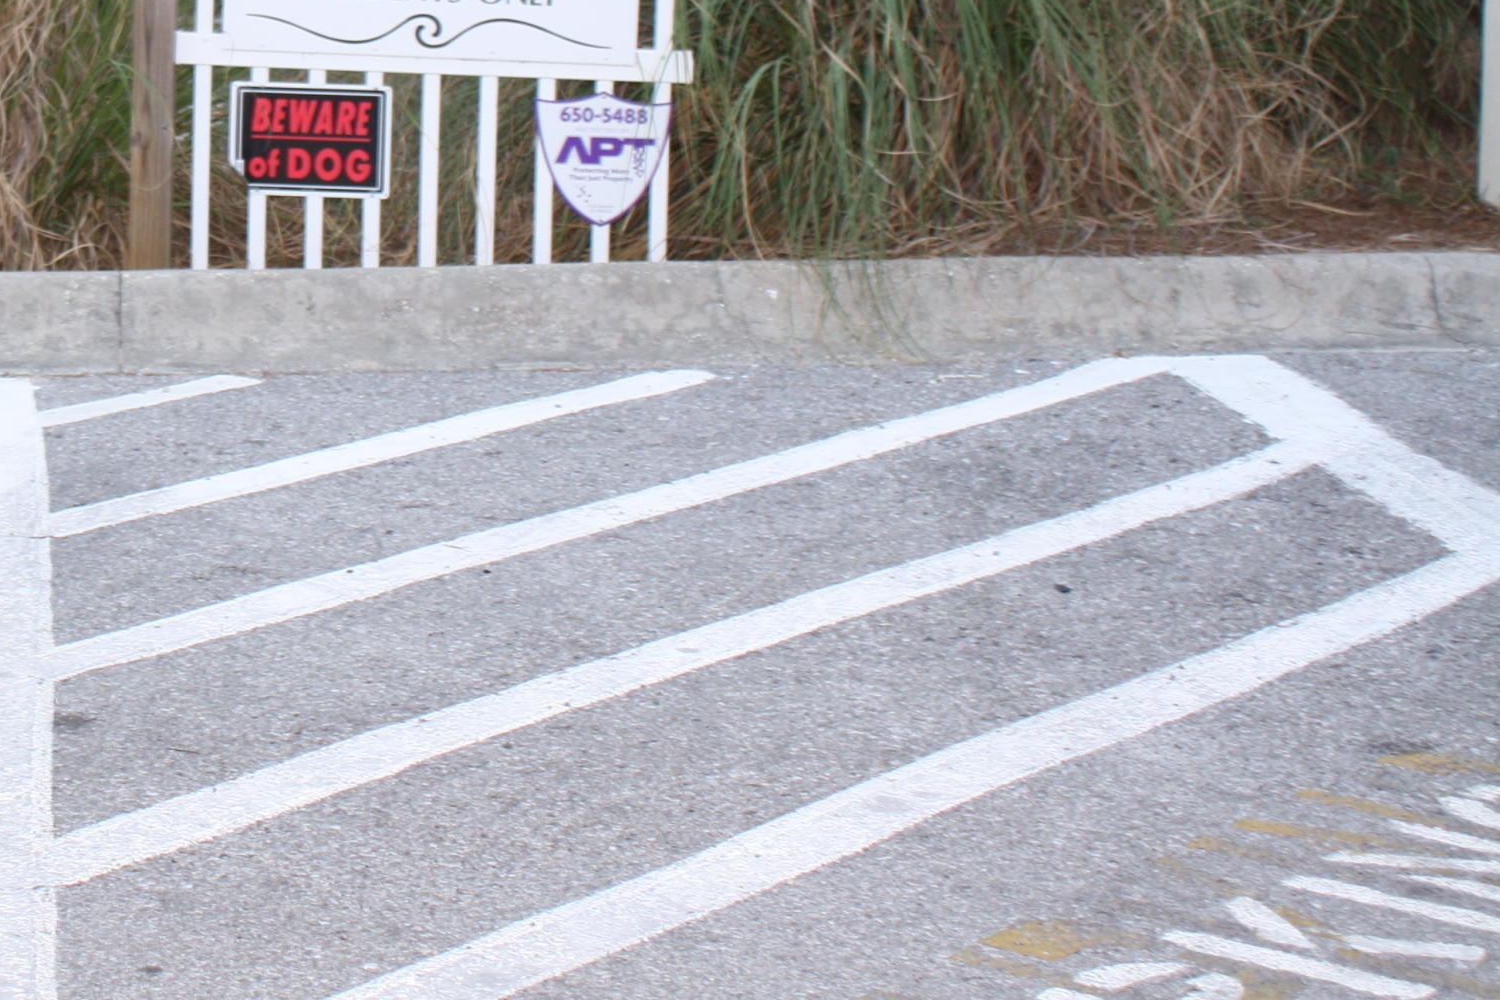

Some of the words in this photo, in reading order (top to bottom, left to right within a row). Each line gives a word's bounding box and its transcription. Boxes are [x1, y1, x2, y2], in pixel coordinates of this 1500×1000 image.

[251, 97, 373, 136] BEWARE
[560, 107, 648, 124] 650-5488
[248, 148, 281, 178] of
[287, 147, 373, 182] DOG
[555, 136, 656, 164] APT
